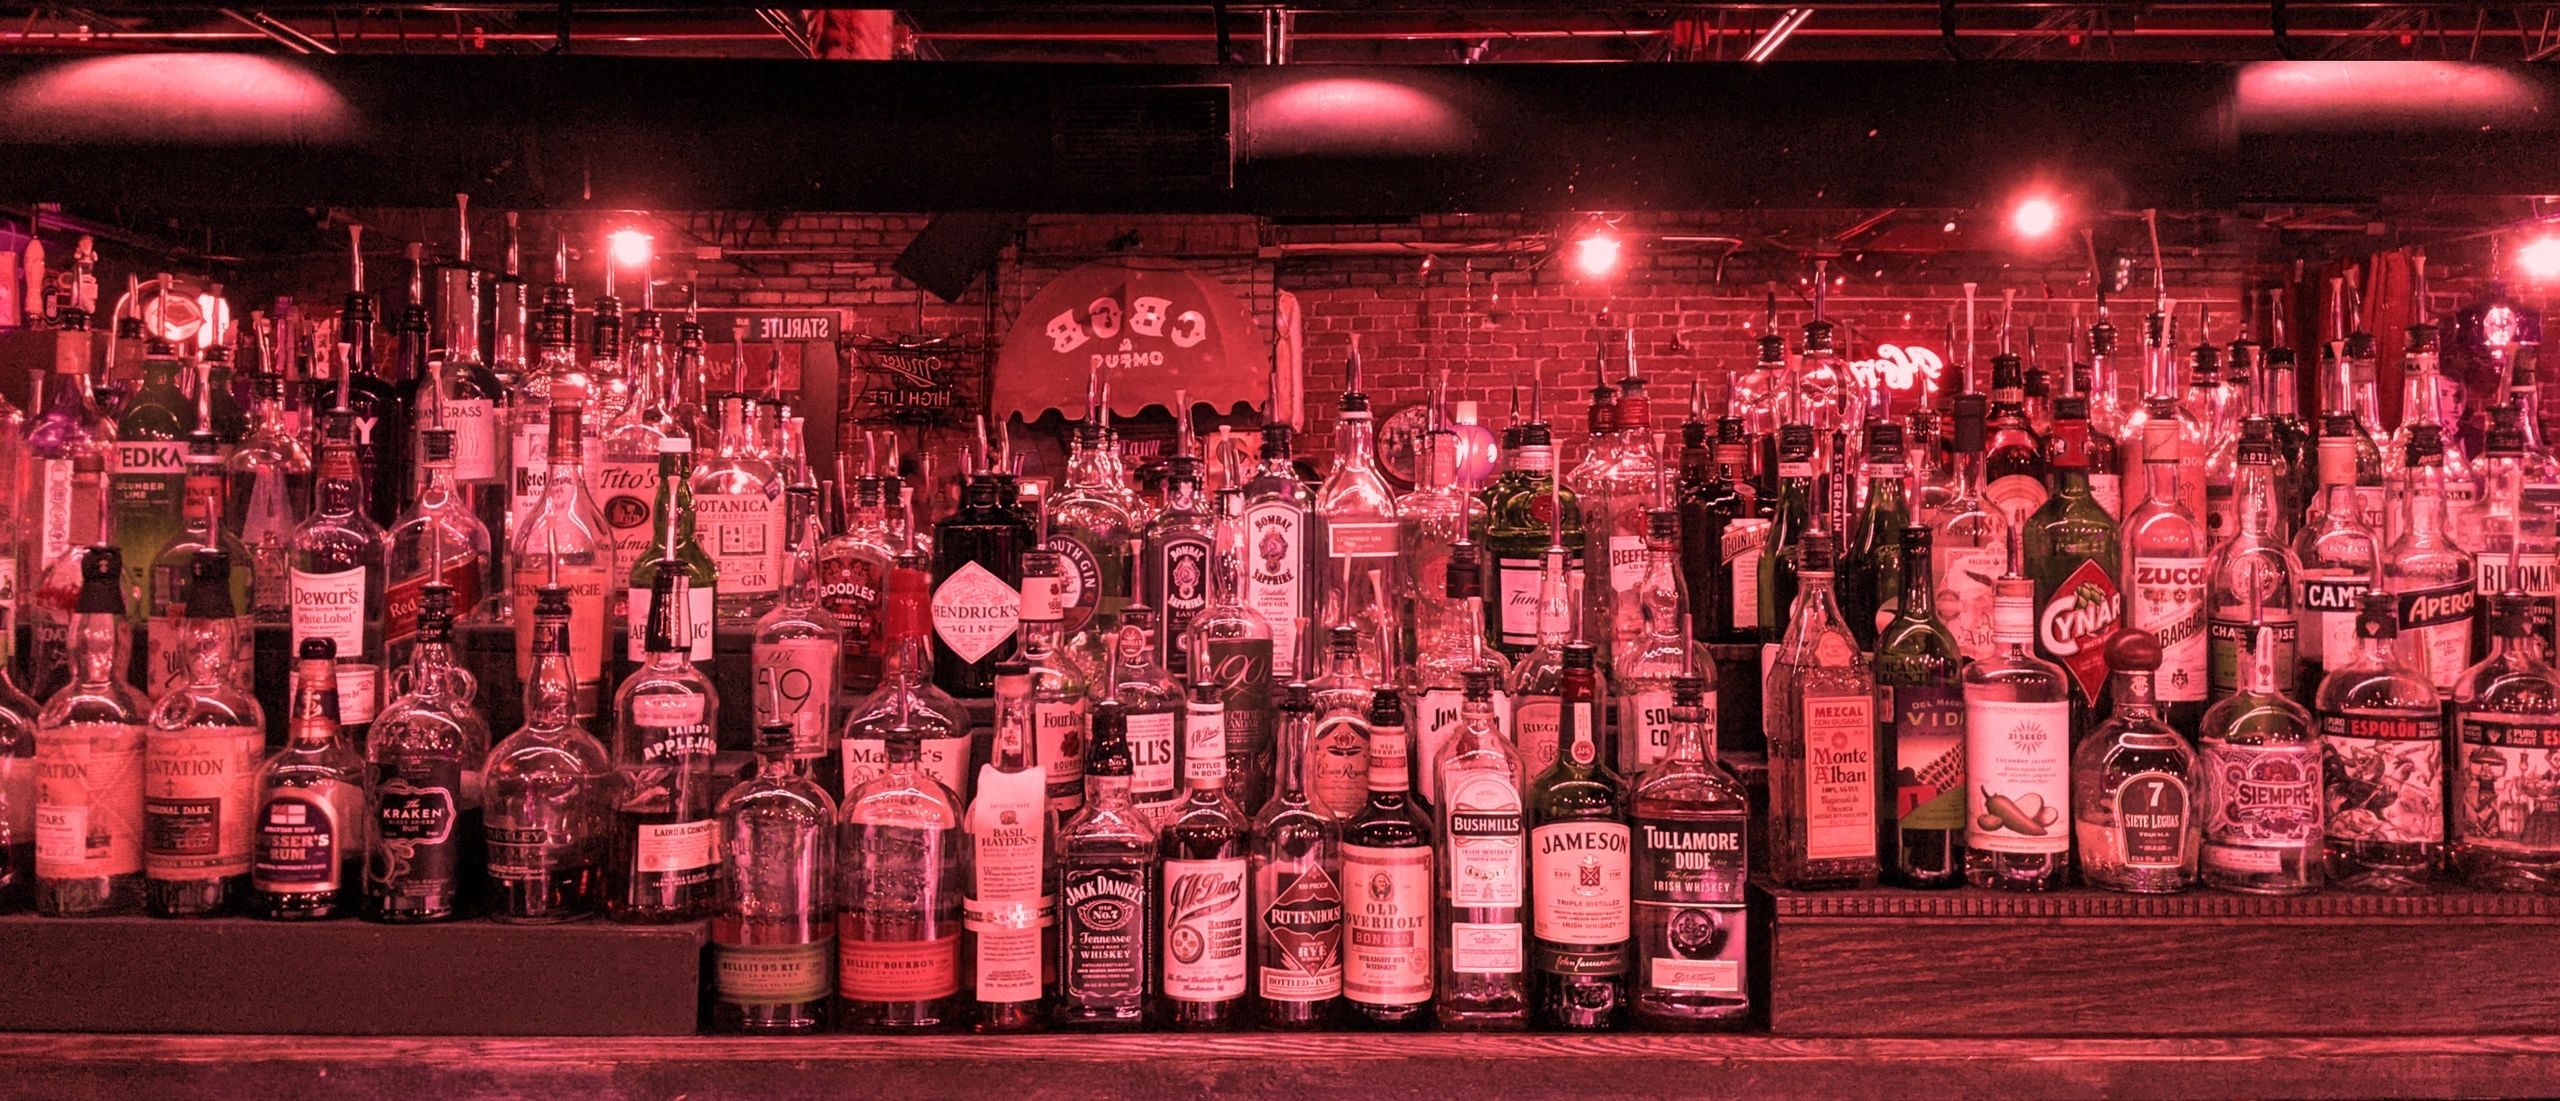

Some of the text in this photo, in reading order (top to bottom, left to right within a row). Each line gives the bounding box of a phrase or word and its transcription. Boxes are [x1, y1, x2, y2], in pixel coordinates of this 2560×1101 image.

[117, 446, 183, 468] EDKA
[117, 481, 165, 491] UCUMBER
[1255, 515, 1293, 532] BOMBAY
[1169, 545, 1205, 561] BOMBAY
[1613, 548, 1648, 567] BEEFE
[741, 575, 767, 586] GIN
[1251, 568, 1295, 586] SAPPHIRE
[294, 586, 359, 606] Dewar's
[820, 582, 876, 602] BOODLES
[389, 597, 418, 618] Red
[1168, 593, 1205, 610] SAPPHIRE
[933, 605, 1020, 619] HENDRICK'S
[629, 622, 709, 640] LAPIG
[957, 624, 987, 634] GIN
[2040, 592, 2121, 656] CYNAR
[1814, 705, 1864, 718] MEZCAL
[1911, 700, 1932, 710] DEL
[1430, 707, 1457, 732] JIM
[667, 723, 710, 737] LAIRD'S
[852, 748, 943, 763] Mar's
[1812, 748, 1868, 765] Monte
[1191, 762, 1221, 770] BOTTLED
[1201, 769, 1221, 777] BOND
[1813, 765, 1867, 784] Alban
[2148, 782, 2165, 807] 7
[2238, 784, 2313, 807] SIEMPRE
[182, 805, 212, 816] DARK
[383, 808, 442, 820] KRAKEN
[1453, 816, 1520, 832] BUSHMILLS
[2125, 813, 2180, 829] SIETE LEGUAS
[993, 828, 1026, 837] BASIL
[1643, 825, 1739, 851] TULLAMORE
[271, 833, 330, 848] SSER'S
[981, 835, 1038, 847] HAYDEN'S
[1542, 832, 1628, 855] JAMESON
[270, 847, 306, 861] RUM
[1065, 880, 1098, 906] JACK
[1097, 875, 1147, 905] DANIEL'S
[1653, 880, 1730, 893] IRISH WHISKEY
[1366, 902, 1398, 915] OLD
[1557, 899, 1583, 907] TRIPLE
[1346, 914, 1425, 930] OVERHOLT
[1585, 921, 1617, 929] WHISKEY
[1080, 932, 1132, 943] Tennessee
[1356, 932, 1412, 946] BONDED
[1080, 950, 1132, 959] WHISKEY
[1298, 946, 1327, 957] RYE
